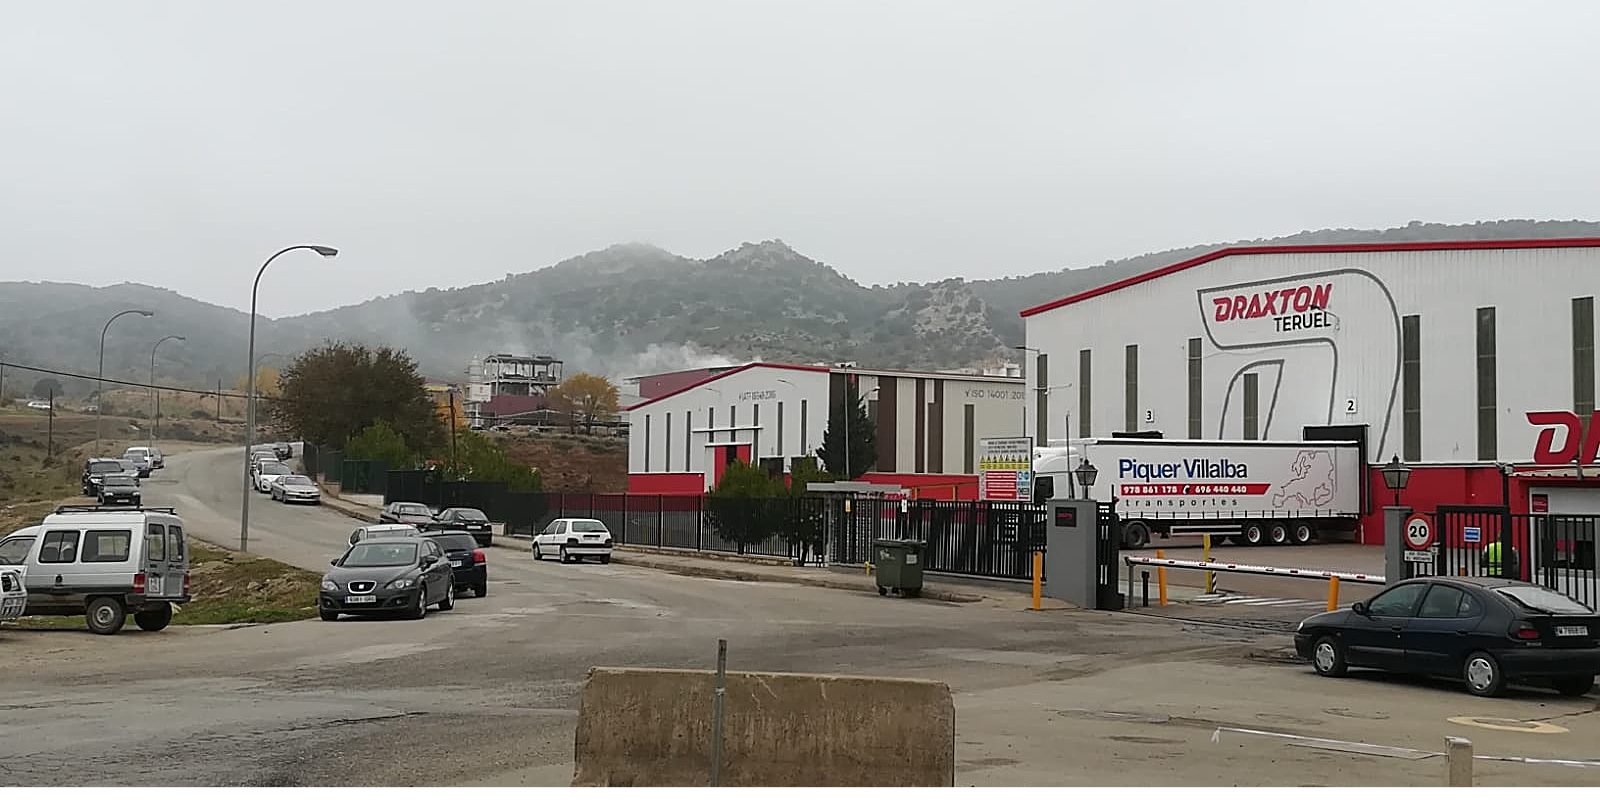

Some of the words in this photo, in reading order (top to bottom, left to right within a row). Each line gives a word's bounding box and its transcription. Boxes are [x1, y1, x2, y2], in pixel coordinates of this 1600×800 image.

[1213, 284, 1333, 322] DRAXTON
[1274, 311, 1331, 332] TERUEL
[1347, 400, 1354, 411] 2
[1146, 410, 1152, 420] 3
[1119, 458, 1180, 482] Piquer
[1183, 458, 1247, 478] Villalba
[1409, 525, 1428, 538] 20
